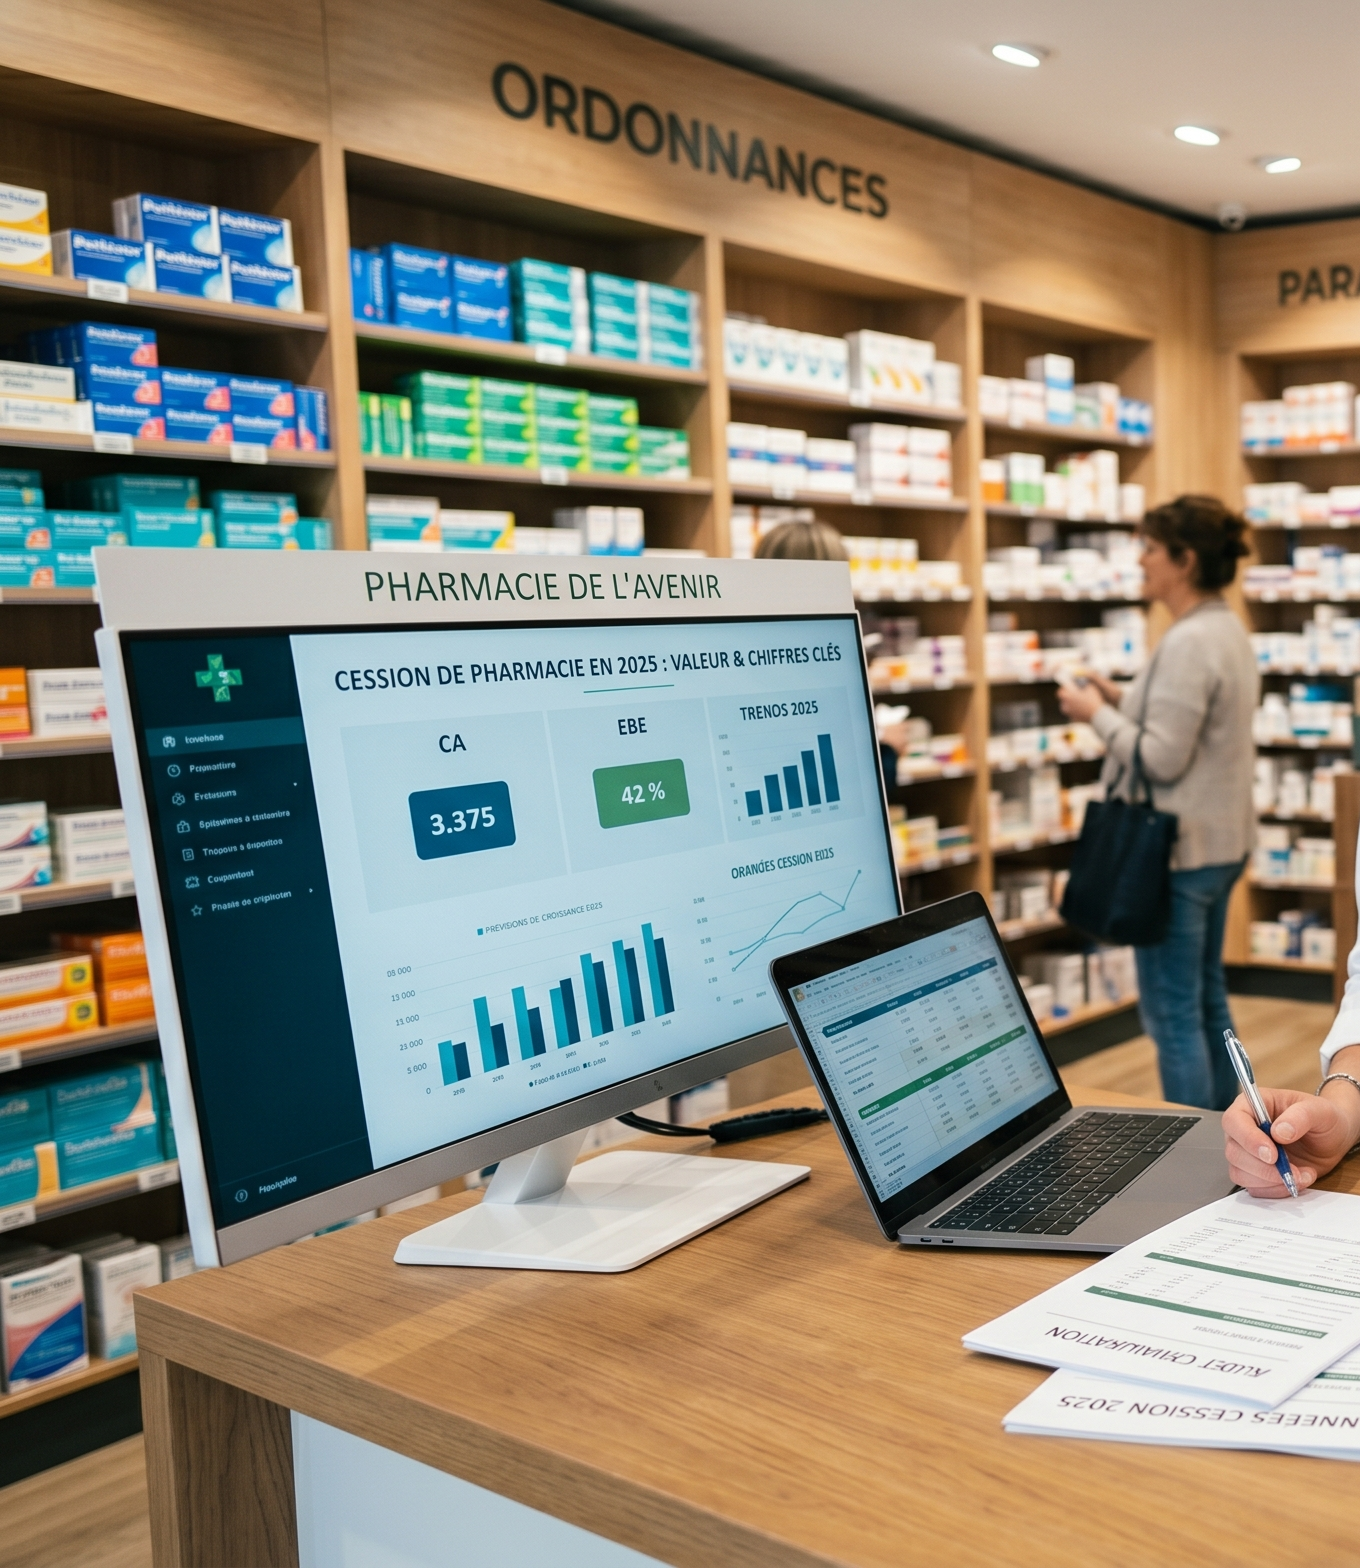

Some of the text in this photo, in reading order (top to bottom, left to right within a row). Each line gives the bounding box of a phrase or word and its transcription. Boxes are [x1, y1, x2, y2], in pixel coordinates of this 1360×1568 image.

[491, 62, 889, 219] ORDONNANCES
[365, 572, 722, 601] PHARMACIE DE L'AVENIR
[334, 666, 431, 691] CESSION
[437, 664, 465, 685] DE
[470, 658, 585, 683] PHARMACIE
[590, 657, 613, 676] EN
[617, 655, 658, 675] 2025
[670, 651, 730, 671] VALEUR
[733, 649, 745, 667] &
[748, 646, 809, 666] CHIFFRES
[812, 642, 842, 662] CLÉS
[791, 700, 819, 715] 2025
[617, 717, 648, 736] EBE
[438, 734, 467, 753] CA
[429, 805, 496, 836] 3.375
[777, 852, 813, 869] CESSION
[529, 915, 540, 924] DE
[541, 905, 585, 922] CROISSANCE
[1056, 1395, 1124, 1412] 2025
[1128, 1402, 1244, 1422] CESSION
